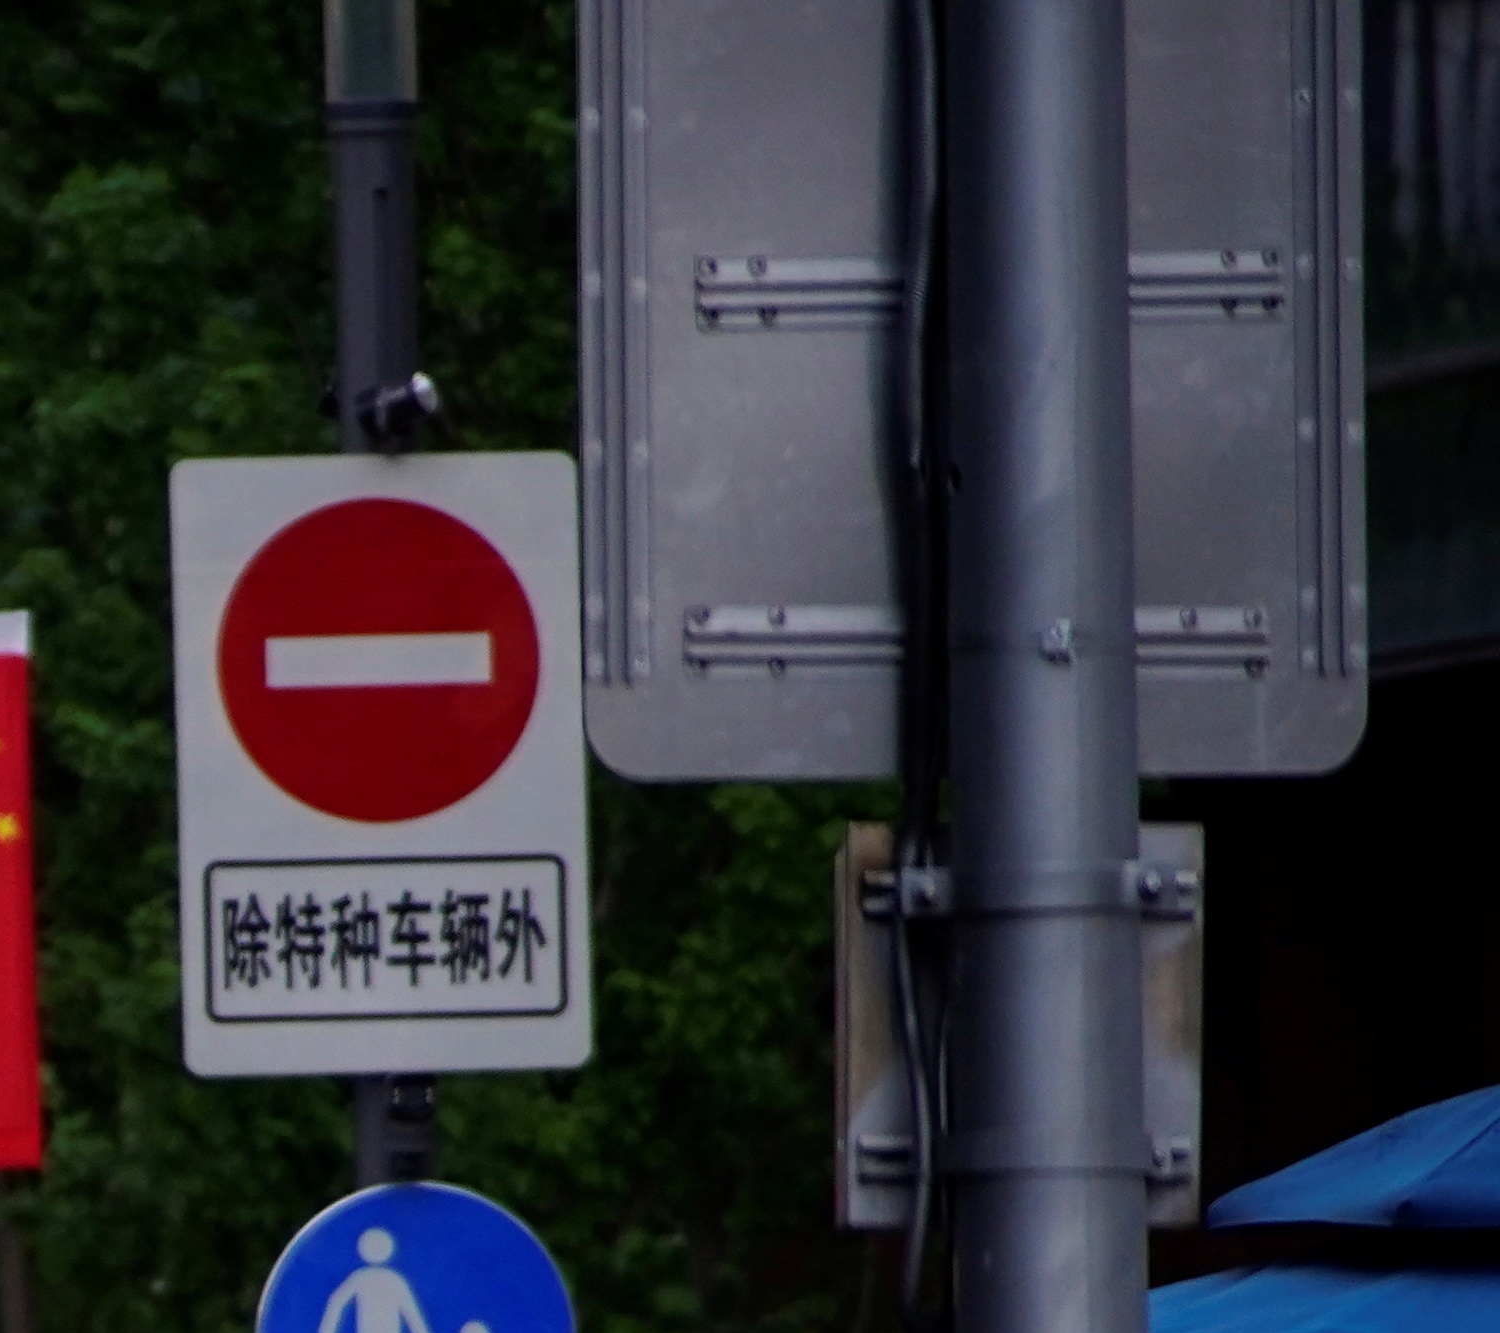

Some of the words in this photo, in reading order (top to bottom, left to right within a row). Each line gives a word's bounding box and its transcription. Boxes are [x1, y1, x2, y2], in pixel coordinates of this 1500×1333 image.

[222, 888, 547, 990] 除特种车辆外
